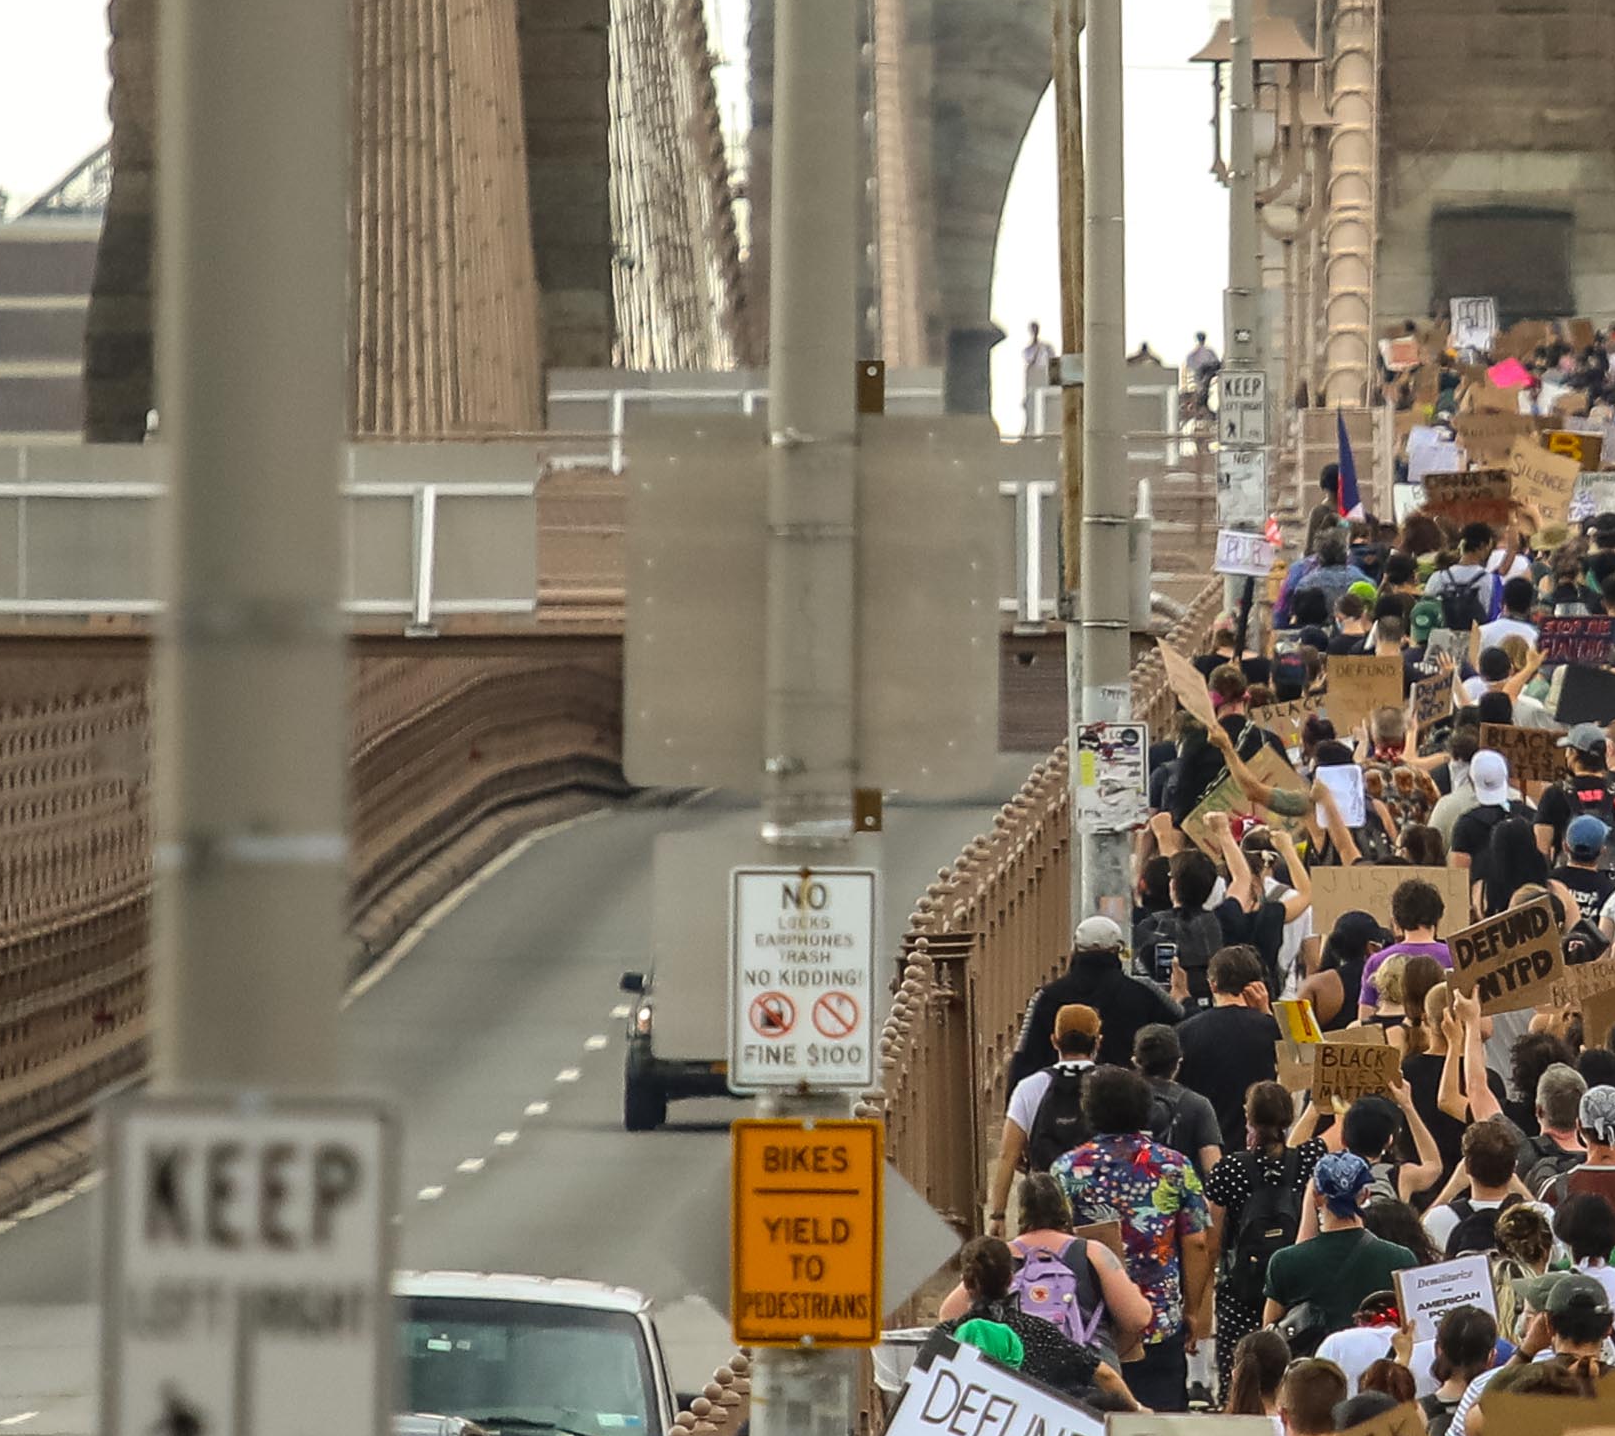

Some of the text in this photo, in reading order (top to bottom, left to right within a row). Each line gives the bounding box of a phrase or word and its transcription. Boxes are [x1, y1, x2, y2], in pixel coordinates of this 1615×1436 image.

[1225, 377, 1261, 397] KEEP
[1261, 692, 1326, 722] BLACK
[782, 883, 827, 911] NO
[755, 933, 854, 948] EARPHONES
[1454, 906, 1550, 970] DEFUND
[779, 950, 831, 965] TRASH
[744, 969, 863, 987] NO KIDDING!
[1478, 949, 1553, 1002] NYPD
[744, 1043, 862, 1067] FINE $100
[1321, 1046, 1386, 1067] BLACK
[1321, 1068, 1384, 1085] LIVES
[762, 1146, 848, 1174] BIKES
[142, 1139, 362, 1251] KEEP
[763, 1217, 850, 1245] YIELD
[791, 1255, 825, 1282] TO
[744, 1292, 868, 1320] PEDESTRIANS
[1417, 1291, 1481, 1311] AMERICAN
